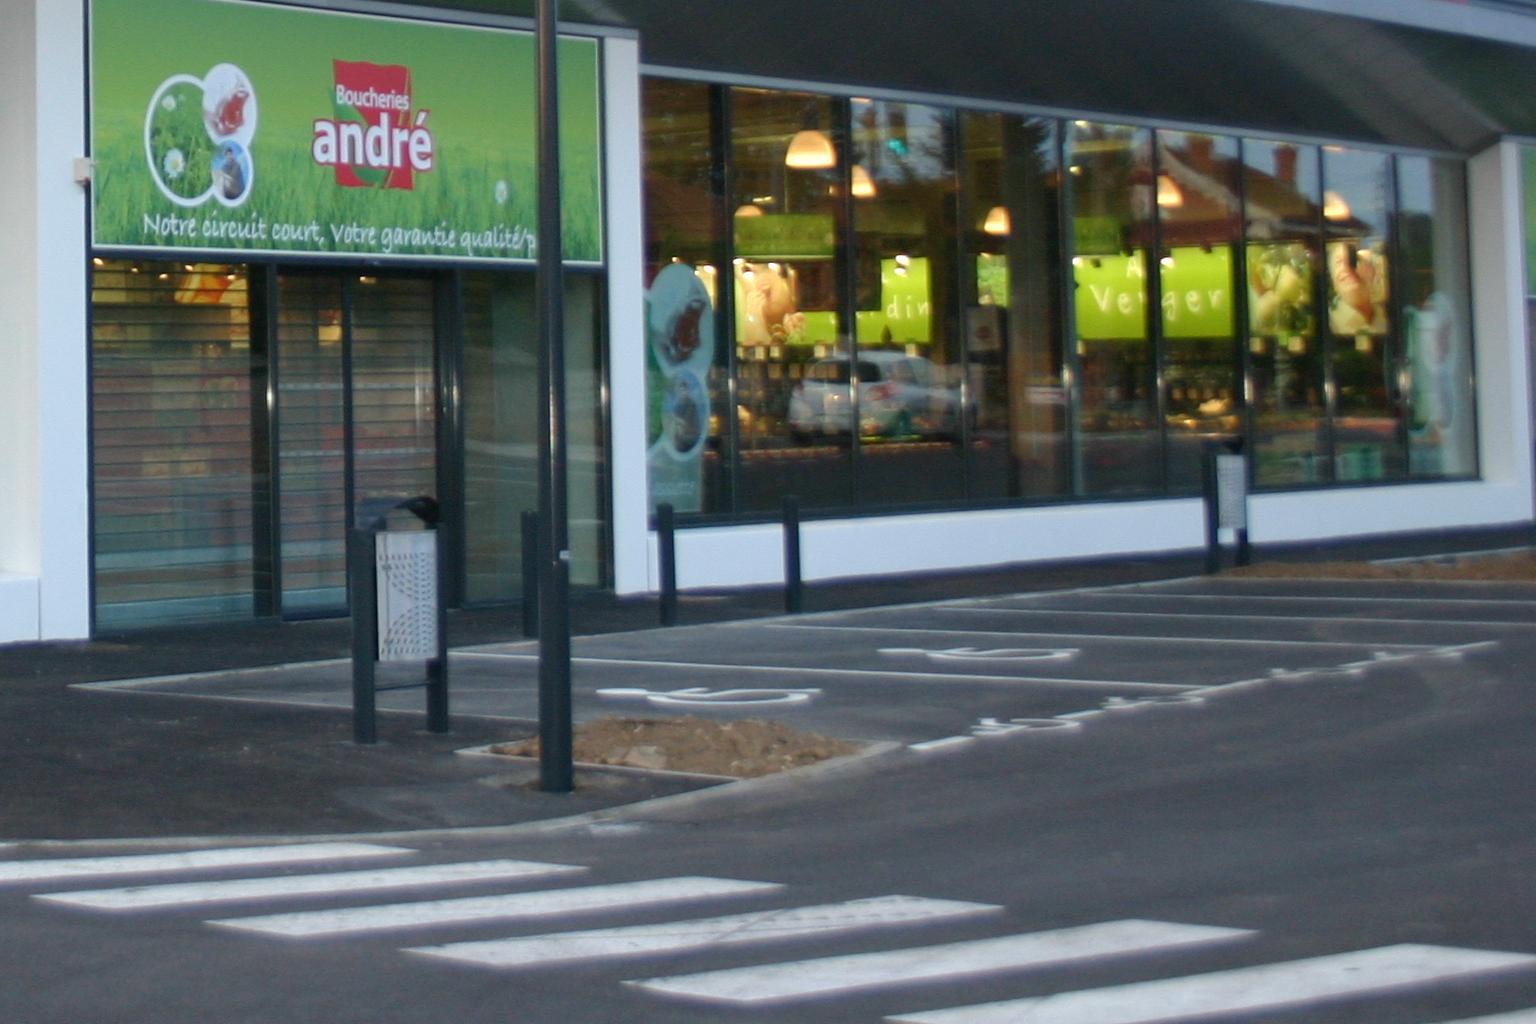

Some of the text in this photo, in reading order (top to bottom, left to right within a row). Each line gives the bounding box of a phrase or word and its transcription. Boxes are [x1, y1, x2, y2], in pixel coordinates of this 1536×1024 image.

[335, 83, 410, 110] Boucheries
[312, 111, 433, 171] andré
[143, 210, 536, 258] Notre circuit court, Votre garantie qualité/p
